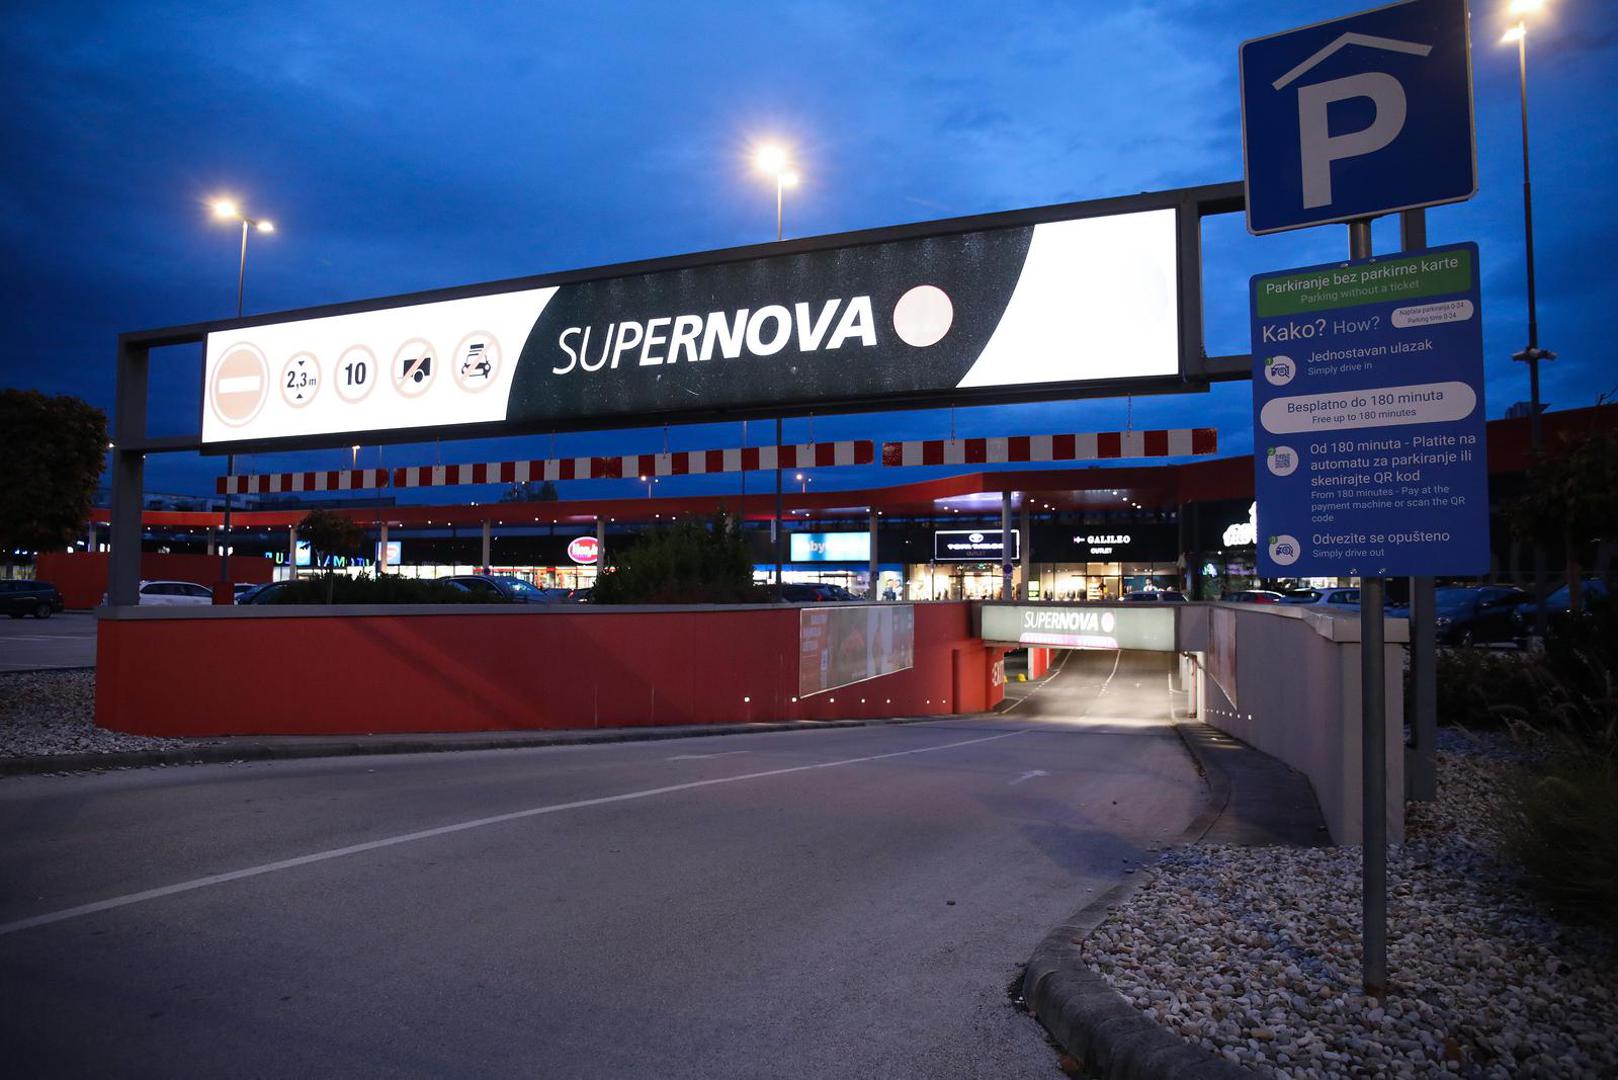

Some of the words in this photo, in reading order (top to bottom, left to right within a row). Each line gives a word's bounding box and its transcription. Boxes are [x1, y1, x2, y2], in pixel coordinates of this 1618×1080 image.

[1298, 72, 1407, 210] P
[1266, 276, 1330, 294] Parkiranje
[1333, 273, 1358, 285] bez
[1361, 265, 1418, 284] parkirne
[1421, 256, 1458, 271] karte
[1301, 290, 1338, 304] Parking
[1341, 285, 1378, 298] without
[1390, 279, 1420, 291] ticket
[553, 296, 877, 375] SUPERNOVA
[1262, 319, 1326, 343] Kako?
[1333, 316, 1380, 335] How?
[1307, 346, 1386, 364] Jednostavan
[1390, 339, 1432, 354] ulazak
[345, 361, 367, 386] 10
[1307, 364, 1338, 376] Simply
[1340, 362, 1361, 372] drive
[1364, 361, 1372, 370] in
[1288, 398, 1347, 415] Besplatno
[1351, 397, 1367, 408] do
[1371, 394, 1393, 406] 180
[1398, 391, 1443, 404] minuta
[1312, 415, 1331, 424] Free
[1333, 415, 1345, 424] up
[1348, 412, 1357, 421] to
[1360, 411, 1376, 420] 180
[1379, 408, 1416, 419] minutes
[1311, 443, 1327, 455] Od
[1331, 442, 1353, 452] 180
[1358, 438, 1400, 451] minuta
[1413, 435, 1455, 448] Platite
[1460, 434, 1476, 444] na
[1311, 458, 1370, 470] automatu
[1373, 457, 1388, 466] za
[1392, 451, 1457, 467] parkiranje
[1461, 450, 1472, 461] ili
[1311, 472, 1370, 488] skenirajte
[1374, 472, 1392, 483] QR
[1396, 471, 1420, 482] kod
[1312, 490, 1334, 499] From
[1338, 489, 1353, 498] 180
[1356, 487, 1393, 497] minutes
[1401, 487, 1419, 496] Pay
[1422, 486, 1431, 494] at
[1434, 485, 1449, 493] the
[1312, 502, 1350, 513] payment
[1353, 499, 1392, 509] machine
[1407, 498, 1430, 507] scan
[1433, 497, 1448, 505] the
[1451, 496, 1465, 506] QR
[1312, 513, 1334, 523] code
[1087, 535, 1131, 544] GALILEO
[1312, 534, 1366, 545] Odvezite
[1370, 534, 1385, 543] se
[1388, 530, 1450, 545] opušteno
[1312, 549, 1343, 559] Simply
[1345, 548, 1367, 557] drive
[1370, 548, 1385, 557] out
[1024, 611, 1099, 631] SUPERNOVA
